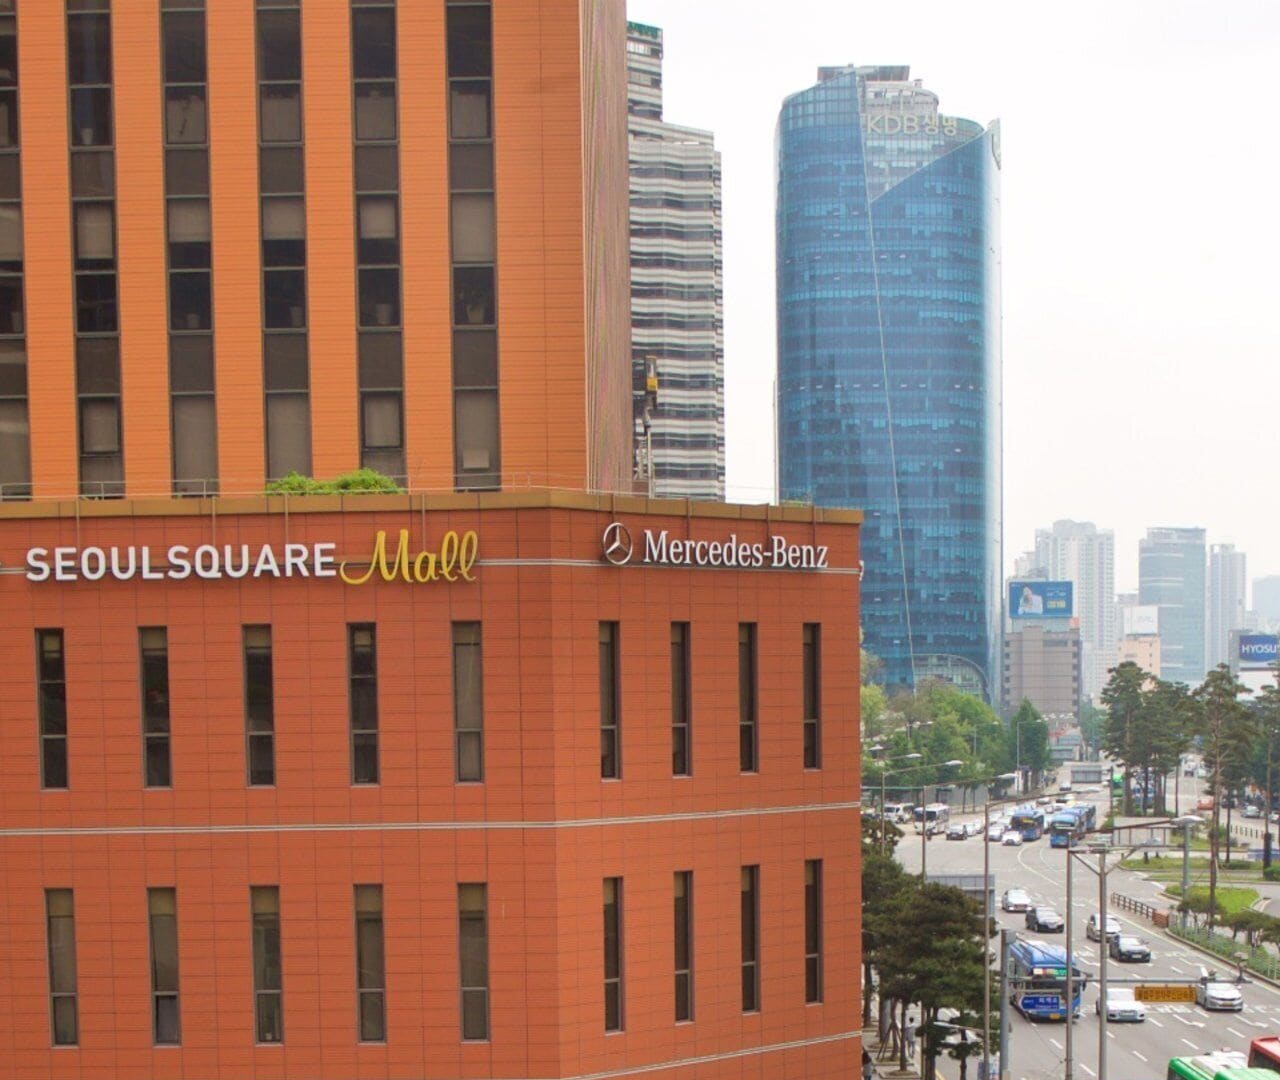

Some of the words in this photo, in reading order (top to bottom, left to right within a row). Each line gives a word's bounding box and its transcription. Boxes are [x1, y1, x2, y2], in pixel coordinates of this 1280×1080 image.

[866, 114, 918, 134] KDB
[923, 113, 957, 136] 생명
[339, 529, 478, 584] Mall
[643, 530, 829, 569] Mercedes-Benz
